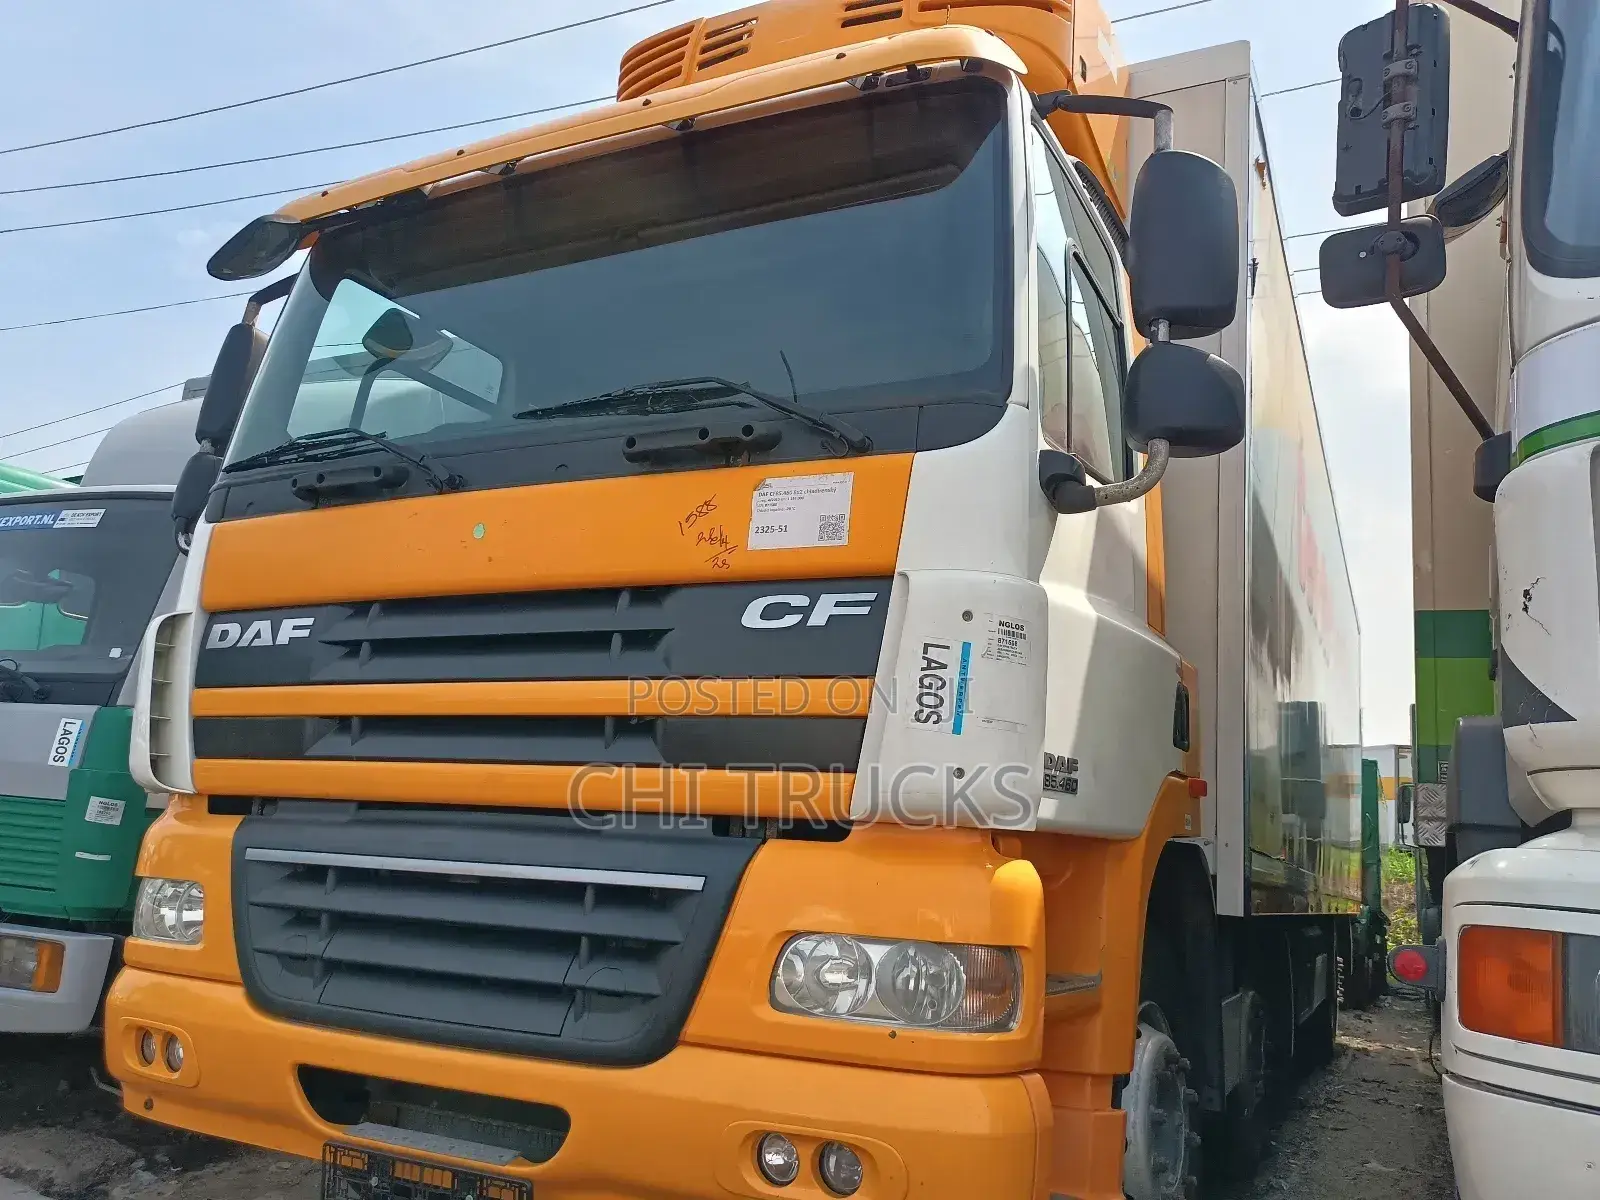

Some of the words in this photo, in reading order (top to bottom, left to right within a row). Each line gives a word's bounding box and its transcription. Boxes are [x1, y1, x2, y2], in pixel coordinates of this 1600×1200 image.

[754, 524, 788, 534] 2325-51
[740, 592, 878, 629] CF
[998, 620, 1025, 632] NGLOS
[205, 617, 315, 650] DAF
[914, 642, 951, 725] LAGOS
[52, 721, 77, 763] LAGOS
[1043, 751, 1079, 775] DAF
